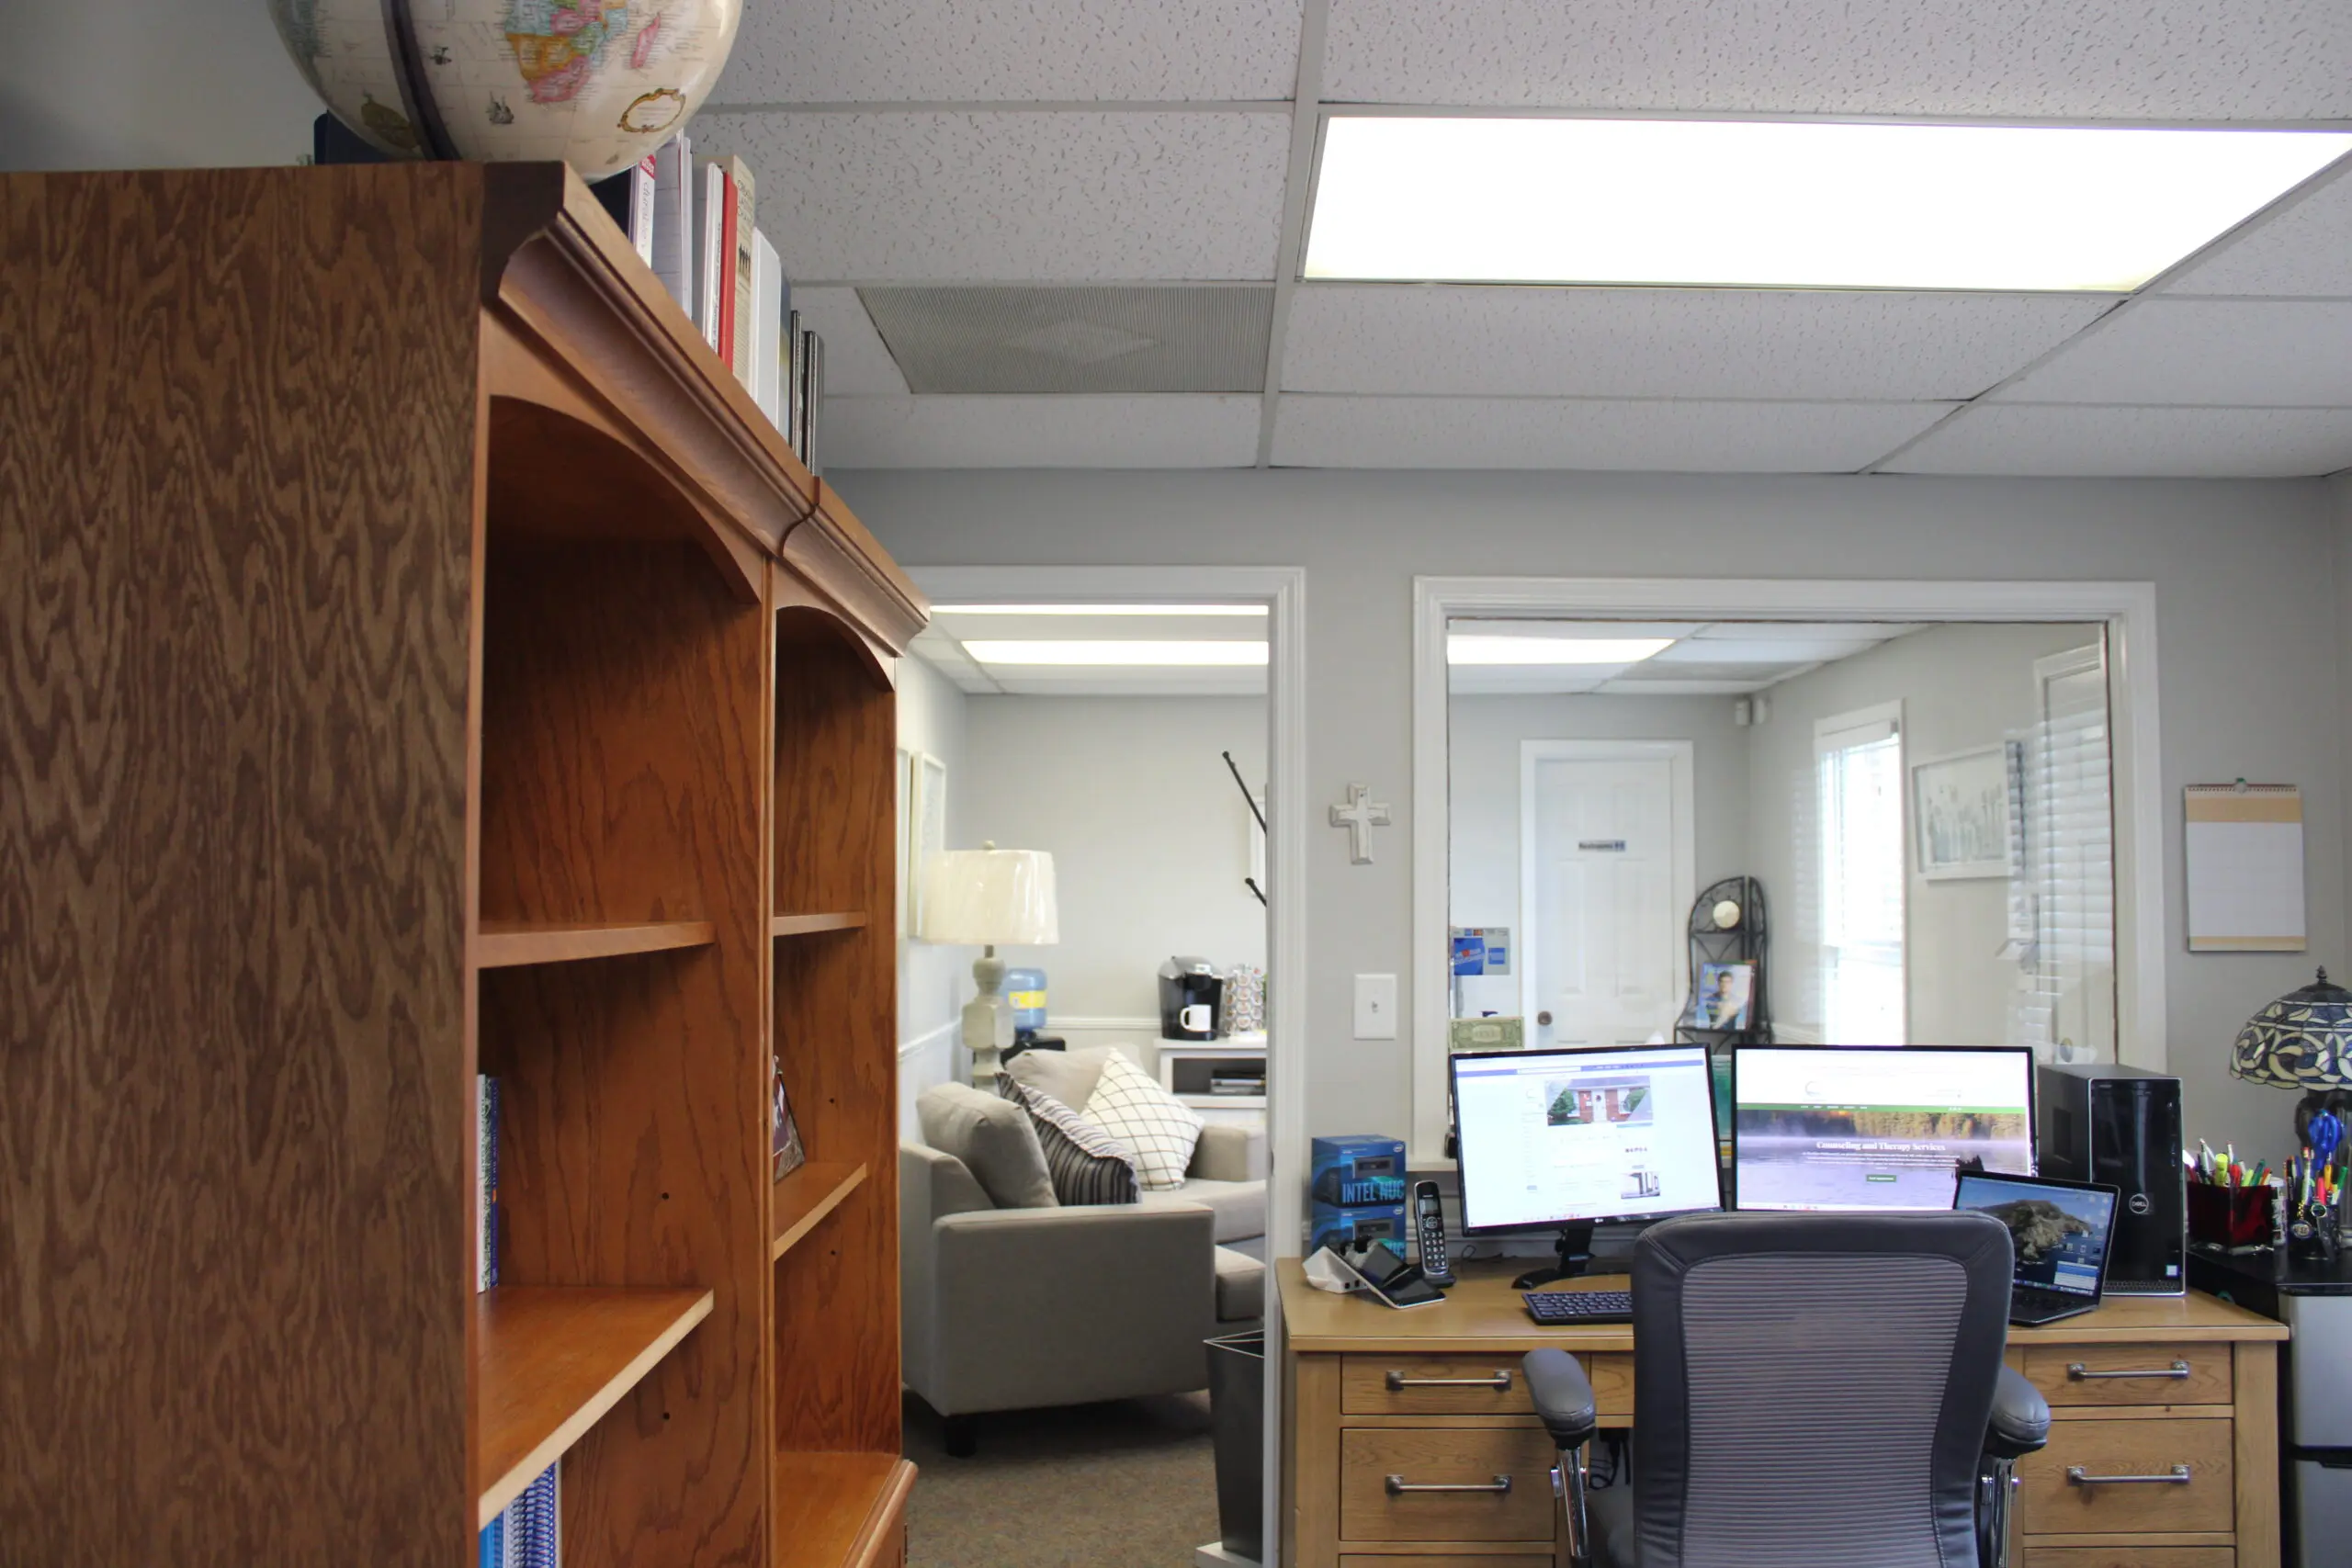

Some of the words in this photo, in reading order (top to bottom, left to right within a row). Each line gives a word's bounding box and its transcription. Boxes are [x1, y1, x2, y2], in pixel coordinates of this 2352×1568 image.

[1816, 1141, 1860, 1150] Counseling
[1879, 1142, 1911, 1152] Therapy
[1913, 1143, 1946, 1151] Services
[1342, 1182, 1377, 1203] INTEL
[1380, 1179, 1404, 1201] NUC
